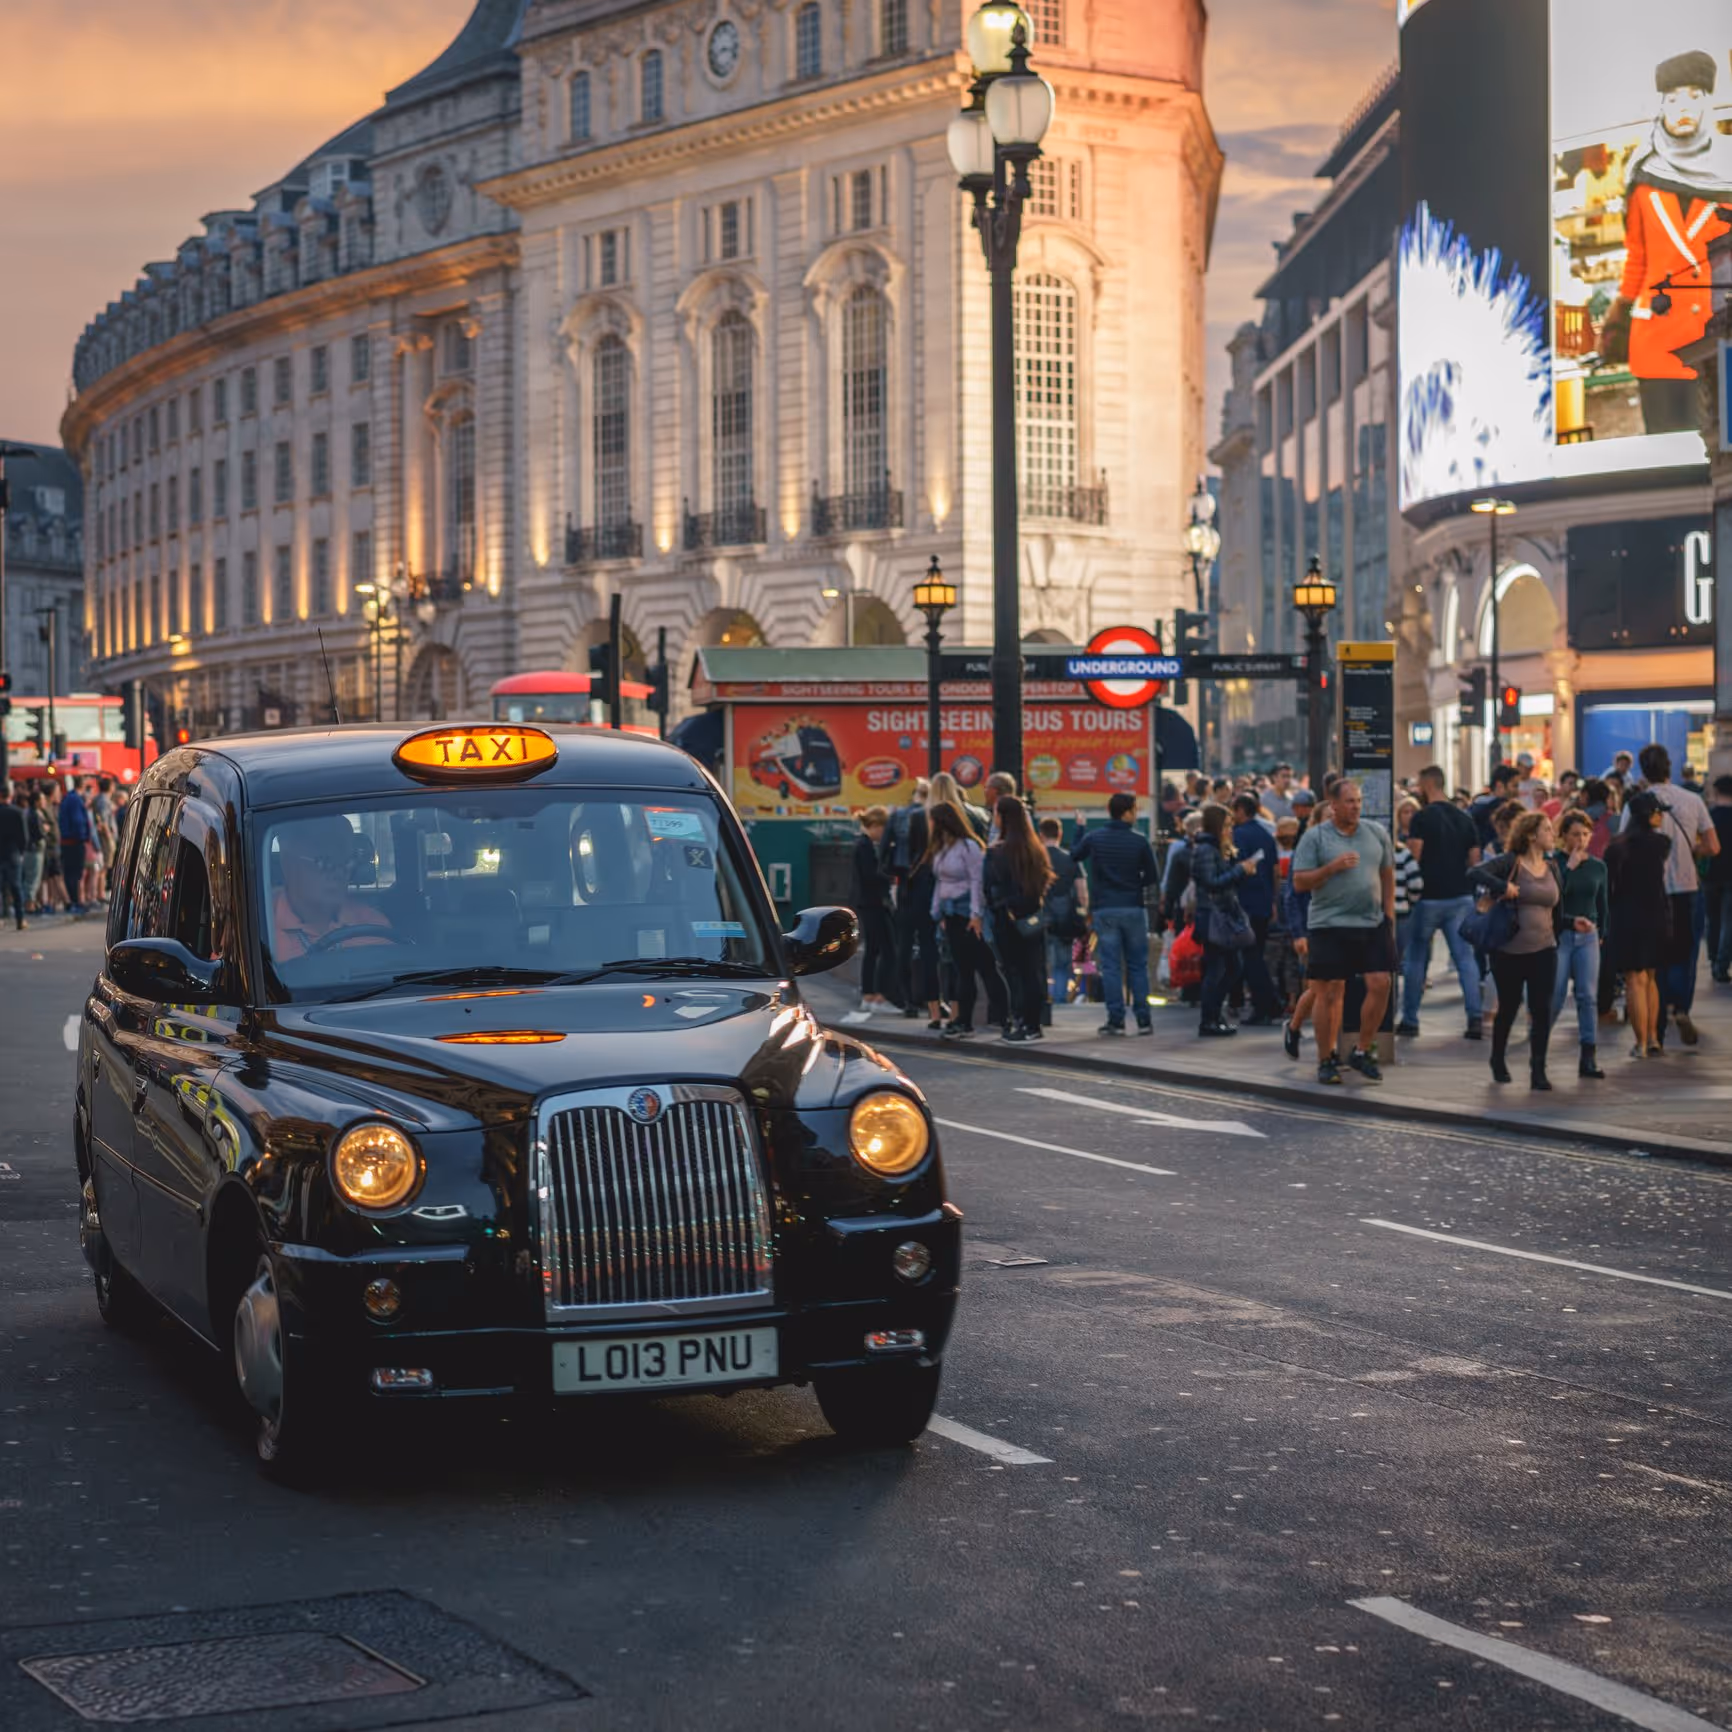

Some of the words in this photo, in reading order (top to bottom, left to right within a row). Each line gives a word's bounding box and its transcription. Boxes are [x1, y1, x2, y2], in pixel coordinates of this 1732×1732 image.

[1068, 660, 1180, 675] UNDERGROUND
[781, 684, 865, 697] SIGHTSEEING
[868, 684, 911, 697] TOURS
[939, 682, 992, 695] ONDON
[867, 710, 994, 732] SIGHTSEEIN
[1023, 710, 1063, 732] BUS
[1070, 710, 1143, 731] TOURS
[435, 737, 529, 763] TAXI
[578, 1341, 666, 1382] LO13
[679, 1334, 752, 1375] PNU
